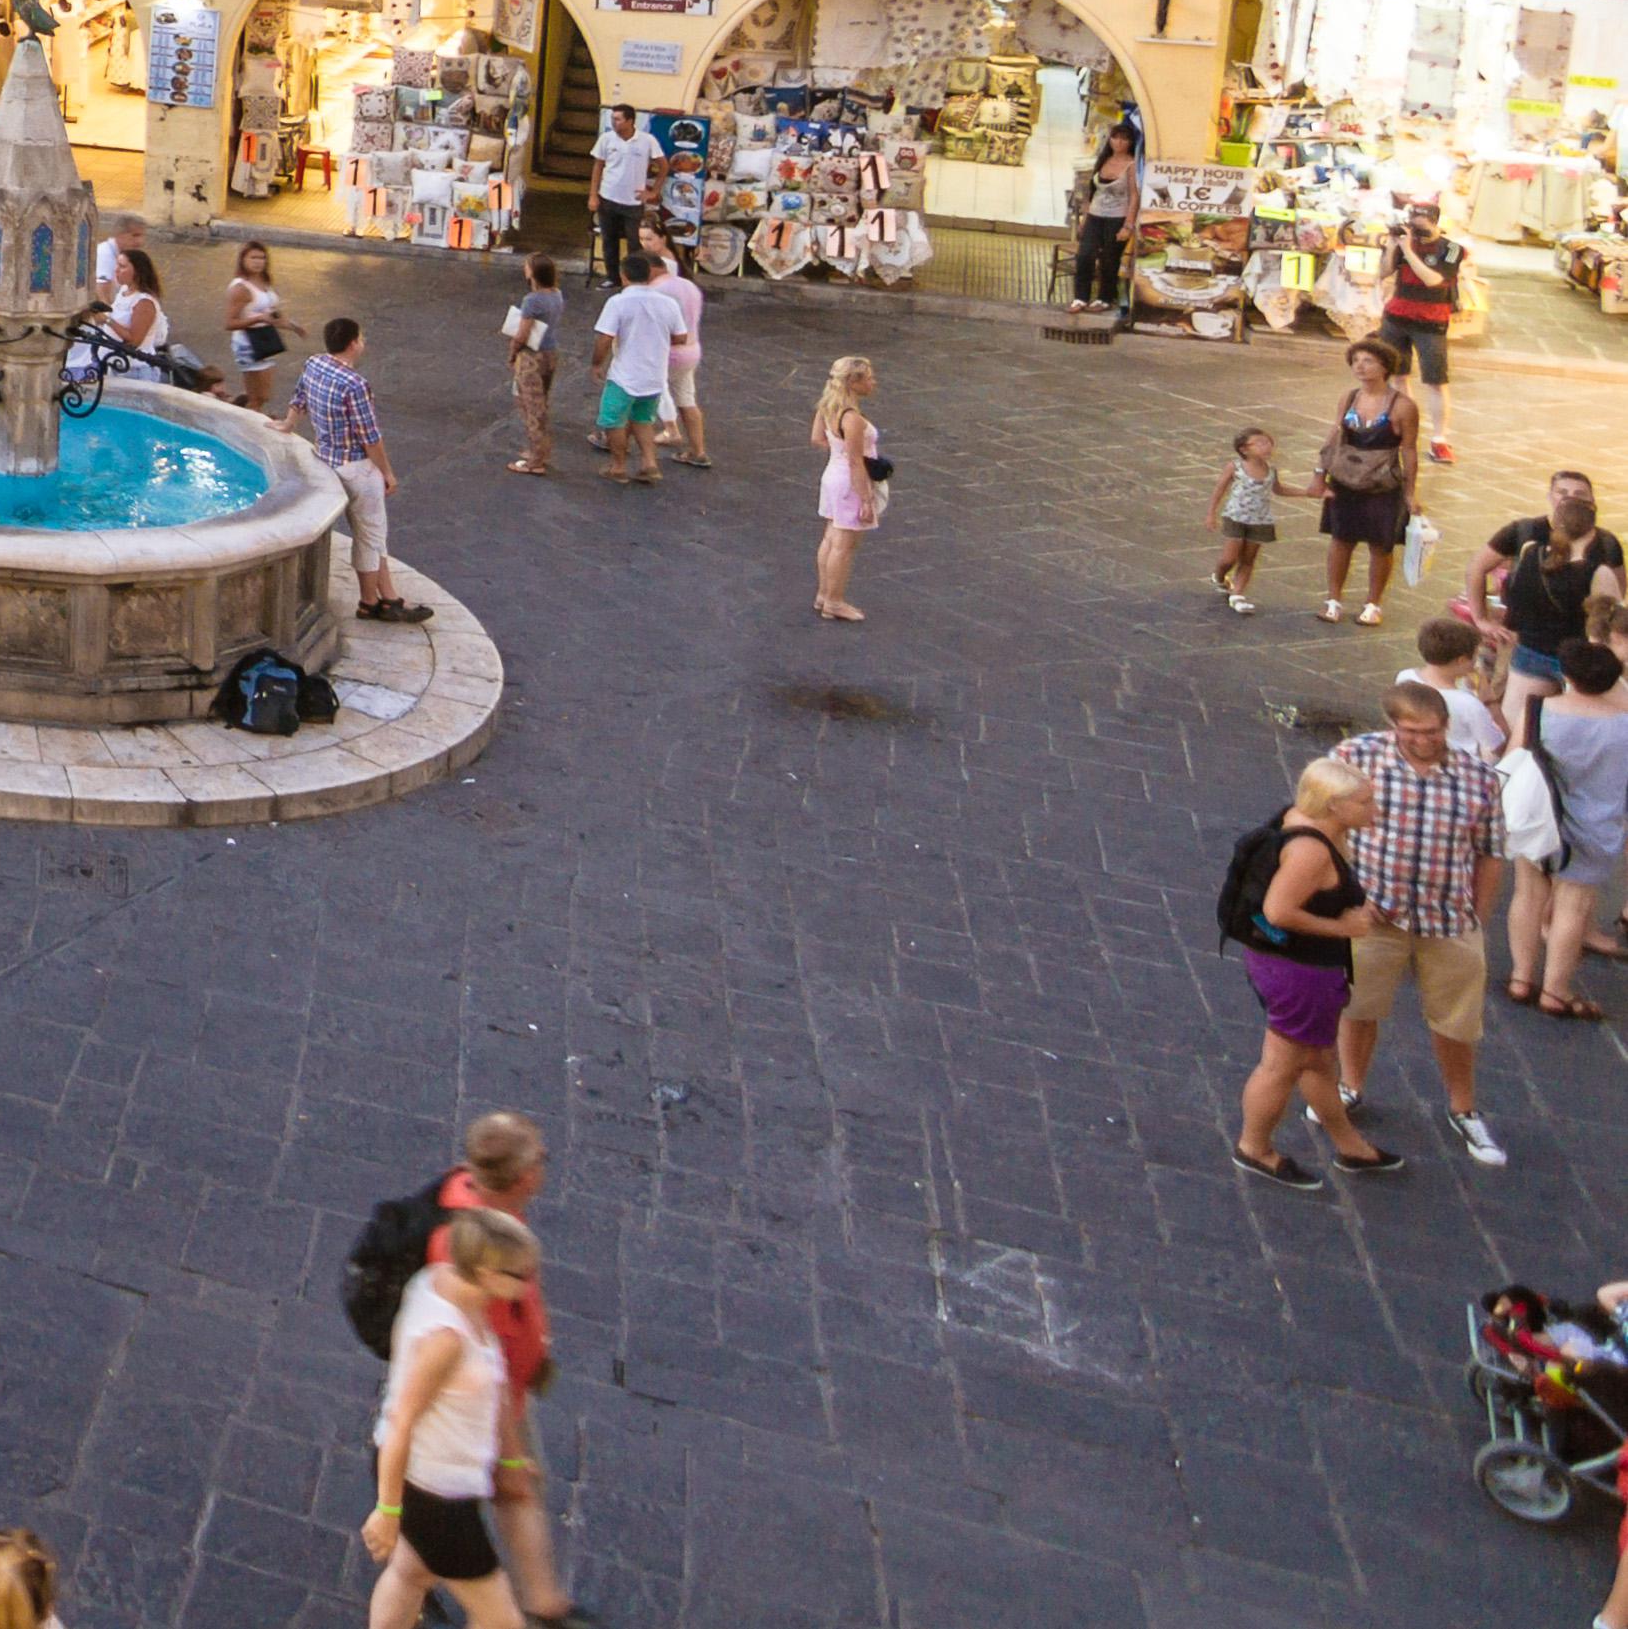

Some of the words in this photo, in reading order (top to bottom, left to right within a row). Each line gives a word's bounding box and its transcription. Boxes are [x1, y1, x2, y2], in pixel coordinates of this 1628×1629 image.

[631, 0, 674, 11] Entrance
[349, 158, 360, 186] 1
[862, 154, 884, 190] 1
[1154, 164, 1200, 178] HAPPY
[1203, 168, 1245, 182] HOUR
[368, 188, 378, 216] 1
[494, 182, 503, 211] 1
[1149, 198, 1174, 211] ALL
[1177, 200, 1244, 216] COFFEES
[1184, 186, 1211, 201] 1€
[453, 219, 464, 248] 1
[771, 221, 785, 249] 1
[871, 210, 885, 242] 1
[829, 226, 845, 257] 1
[1287, 256, 1301, 288] 1
